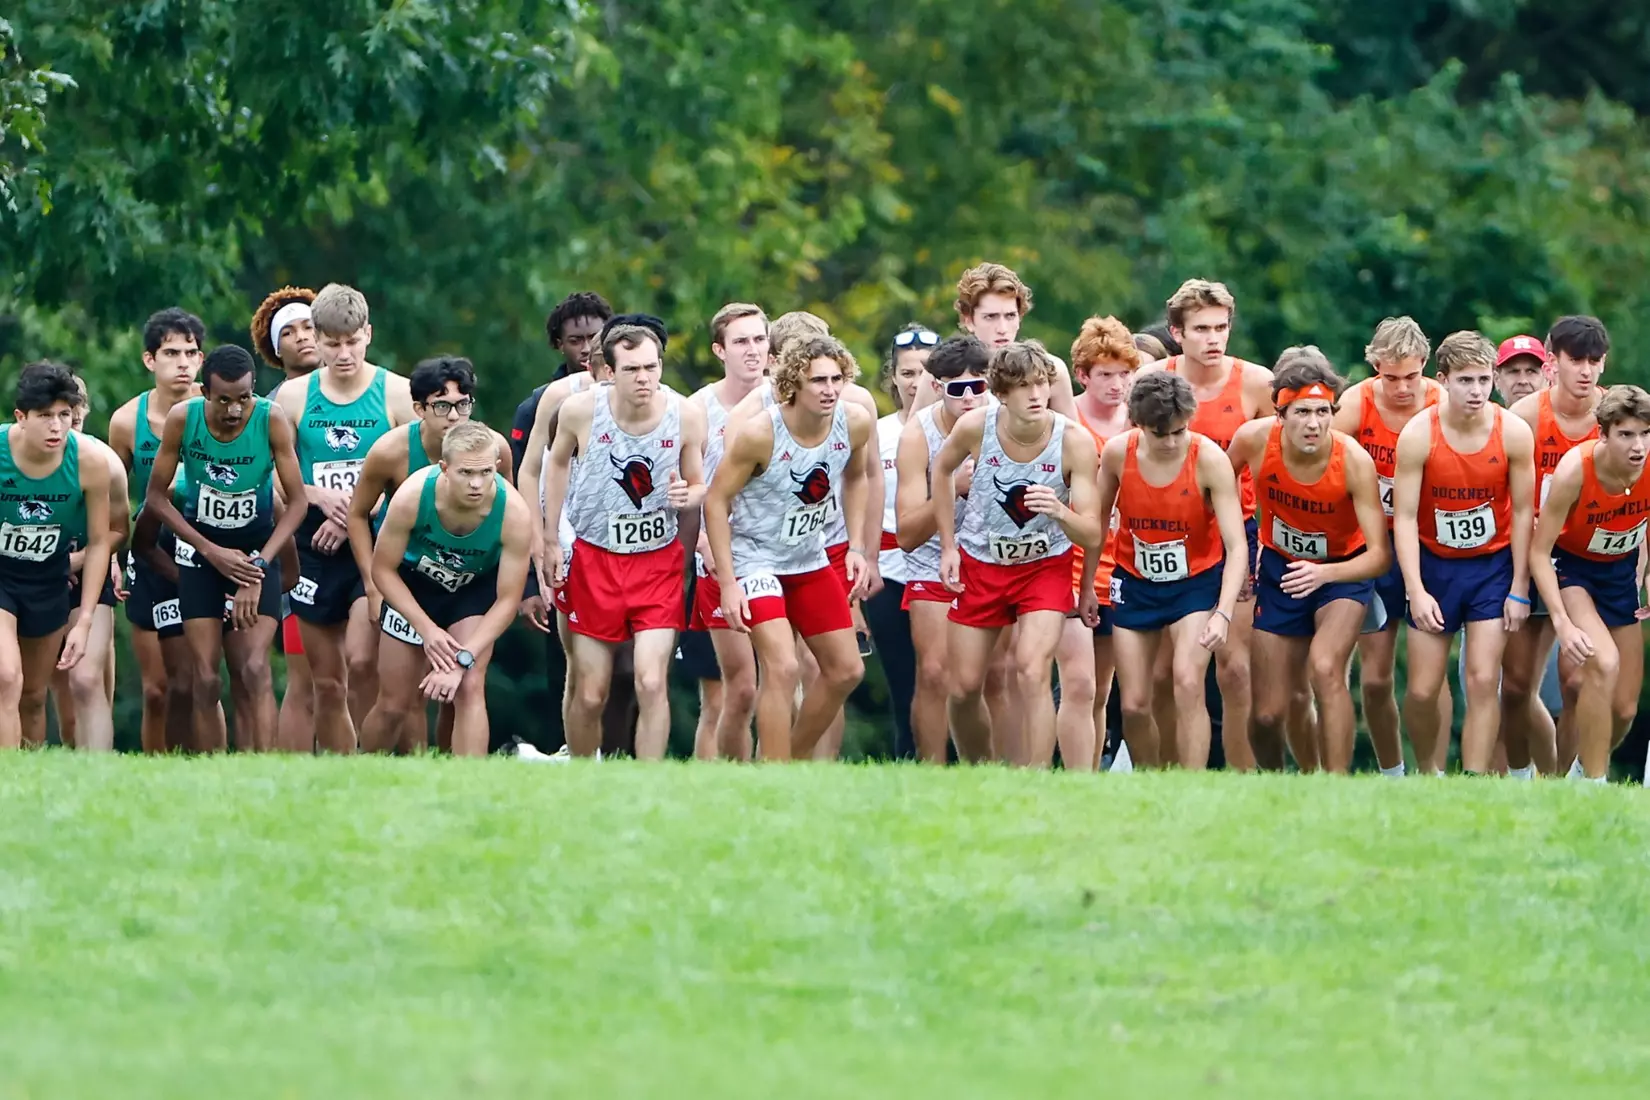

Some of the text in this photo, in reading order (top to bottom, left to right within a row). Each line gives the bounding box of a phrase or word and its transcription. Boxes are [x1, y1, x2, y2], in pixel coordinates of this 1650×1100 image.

[1513, 338, 1532, 350] R
[308, 419, 379, 429] UTAH VALLEY
[188, 449, 256, 466] UTAH VALLEY
[317, 471, 361, 491] 163
[32, 493, 72, 503] VALLEY
[1268, 486, 1336, 515] BUCKNELL
[1432, 485, 1496, 501] BUCKNELL
[202, 496, 254, 521] 1643
[611, 516, 666, 545] 1268
[787, 504, 829, 537] 1264
[1128, 517, 1191, 532] BUCKNELL
[1445, 515, 1486, 541] 139
[3, 532, 58, 554] 1642
[993, 539, 1049, 560] 1273
[1280, 530, 1319, 556] 154
[1602, 530, 1639, 550] 141
[1139, 551, 1178, 574] 156
[293, 581, 313, 598] 37
[742, 577, 778, 596] 1264
[388, 613, 418, 640] 1641
